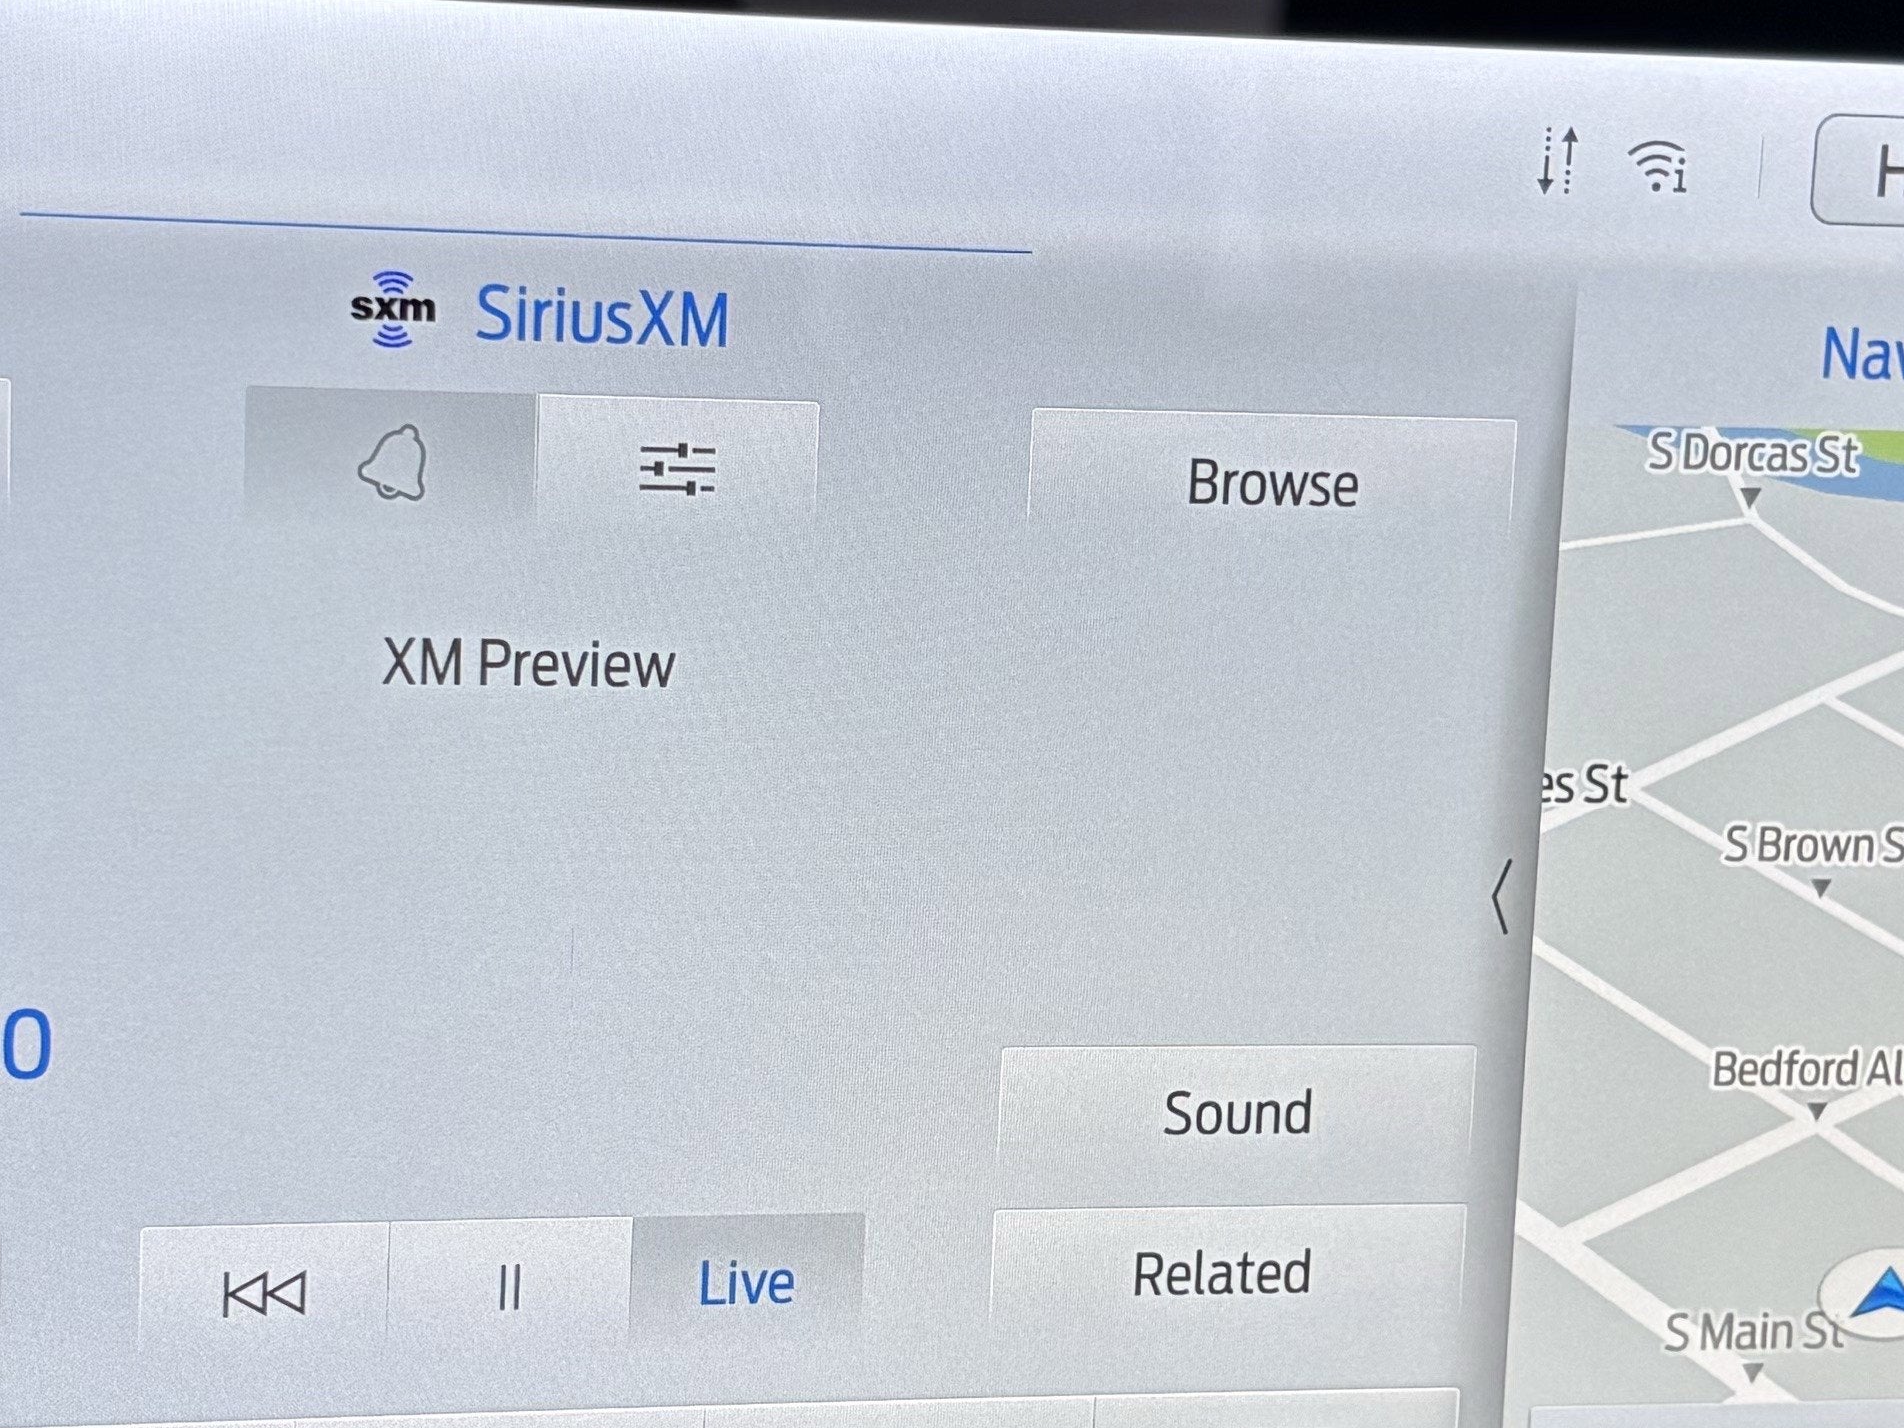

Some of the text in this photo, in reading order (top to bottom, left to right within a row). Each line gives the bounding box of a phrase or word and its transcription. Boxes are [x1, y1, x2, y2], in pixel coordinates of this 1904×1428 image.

[350, 283, 729, 349] sxm SiriusXM
[1649, 433, 1857, 476] S Dorcas St
[1188, 456, 1360, 508] Browse
[382, 636, 677, 689] XM Preview
[1583, 763, 1629, 803] St
[1725, 826, 1748, 863] S
[1758, 827, 1873, 864] Brown
[1713, 1048, 1860, 1088] Bedford
[1163, 1087, 1314, 1137] Sound
[700, 1259, 796, 1307] Live
[1134, 1247, 1313, 1298] Related
[1664, 1312, 1689, 1352] S
[1700, 1312, 1793, 1351] Main
